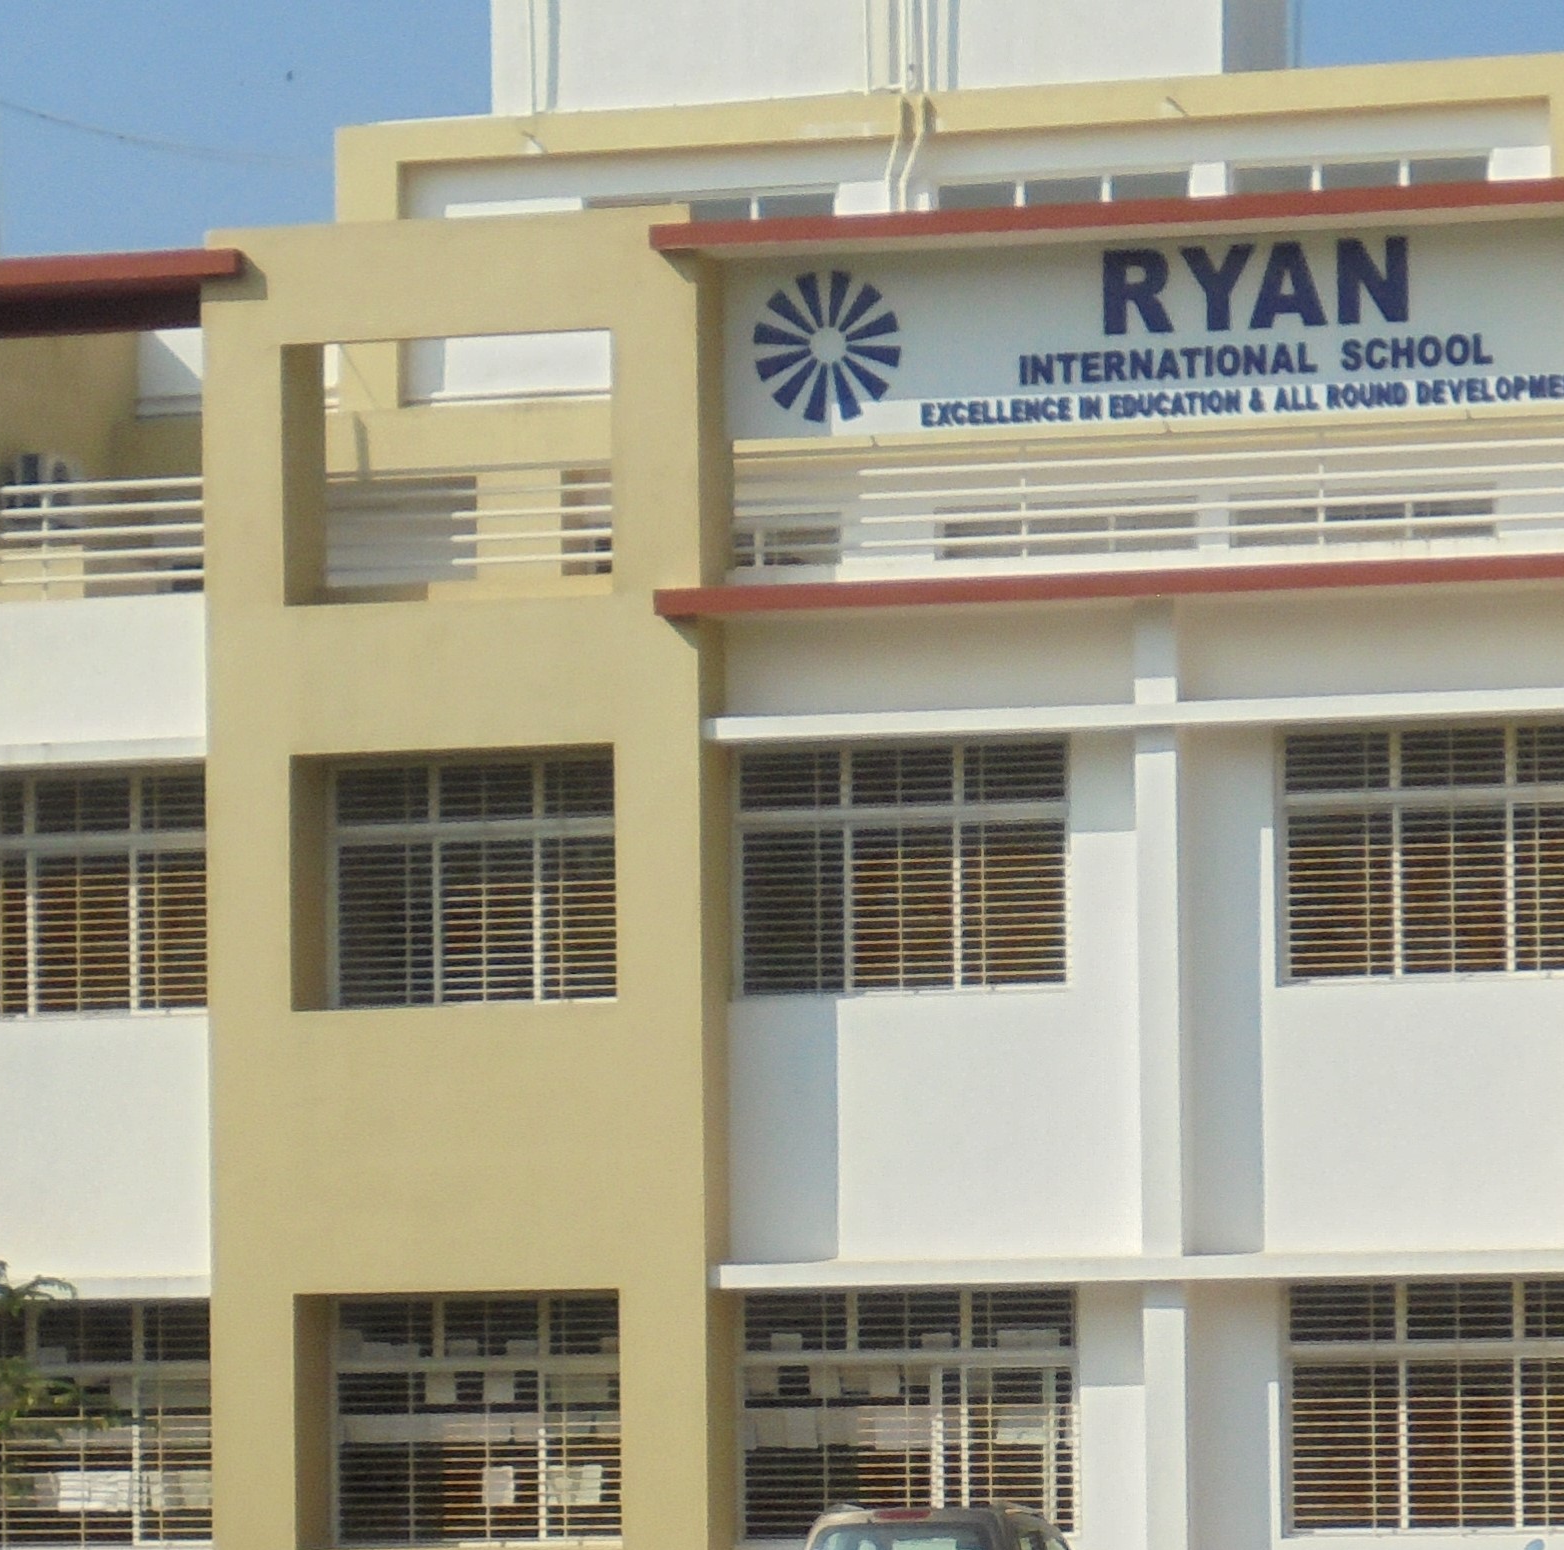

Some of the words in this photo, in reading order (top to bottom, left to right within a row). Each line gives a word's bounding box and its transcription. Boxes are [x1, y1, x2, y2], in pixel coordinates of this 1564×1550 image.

[1102, 235, 1410, 335] RYAN
[1019, 341, 1318, 387] INTERNATIONAL
[1341, 333, 1493, 371] SCHOOL
[921, 396, 1073, 427] EXCELLENCE
[1079, 394, 1103, 421] IN
[1109, 388, 1242, 419] EDUCATION
[1248, 387, 1265, 412] &
[1274, 384, 1320, 412] ALL
[1326, 381, 1410, 409] ROUND
